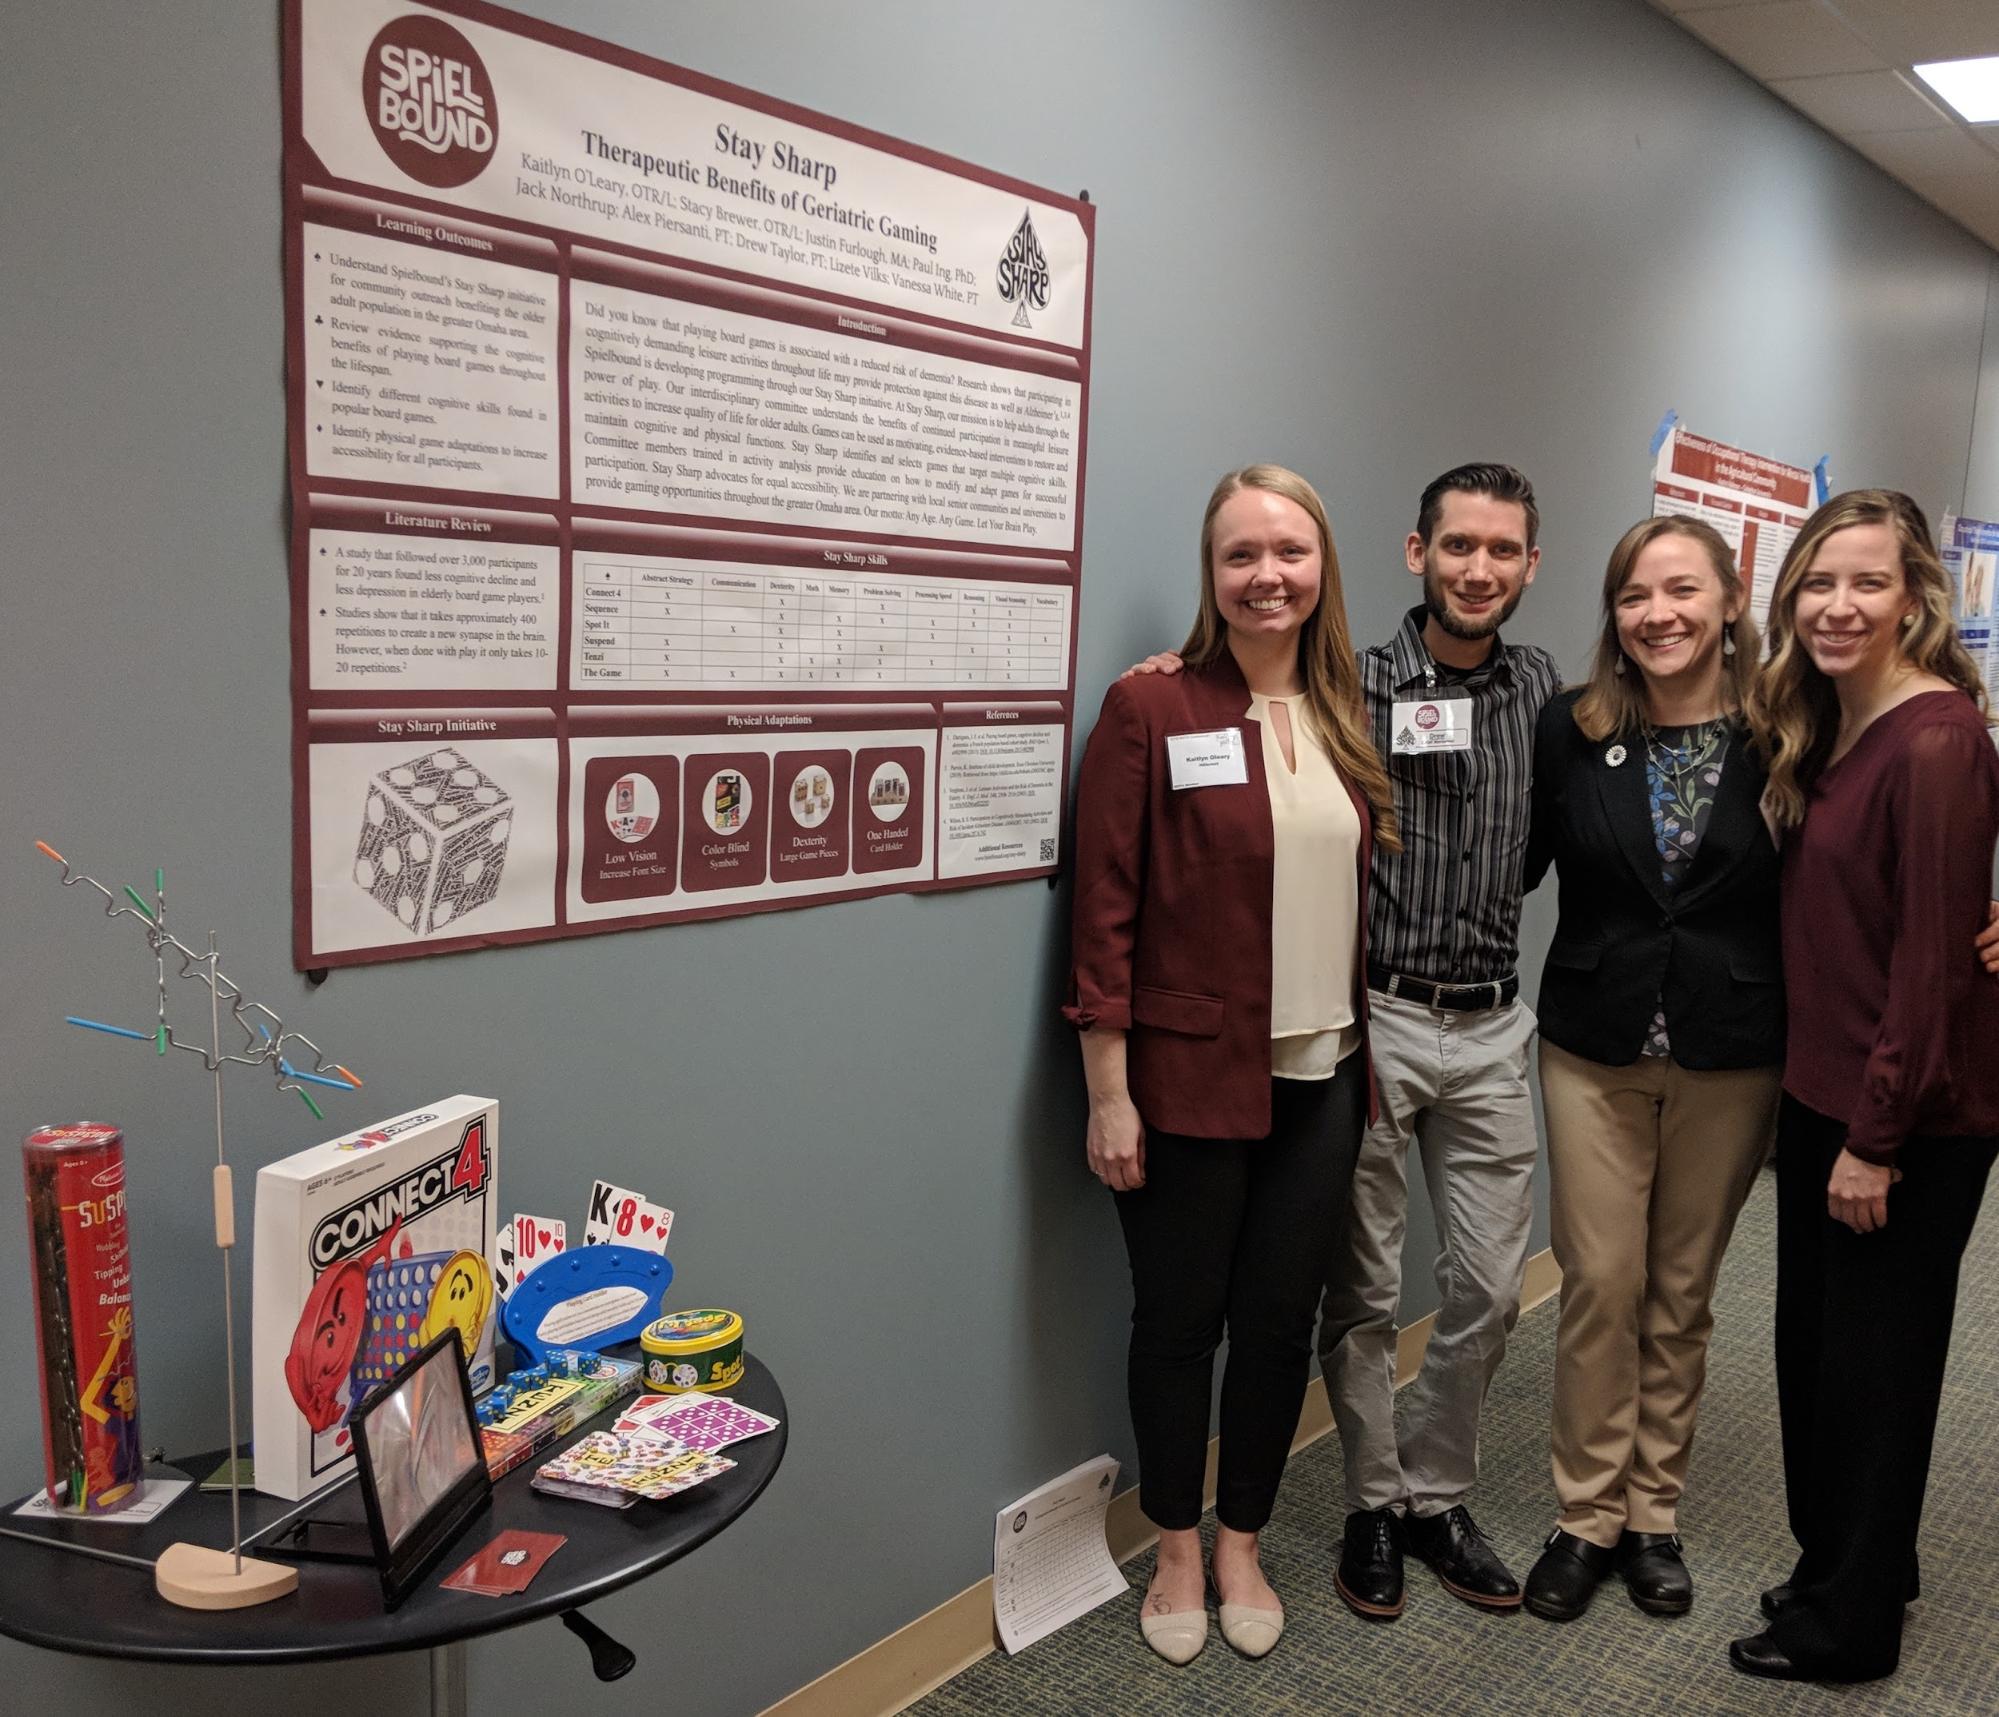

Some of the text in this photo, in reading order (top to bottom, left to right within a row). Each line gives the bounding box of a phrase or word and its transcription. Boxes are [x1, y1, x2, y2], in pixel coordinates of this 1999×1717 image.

[379, 84, 493, 154] BOUND
[681, 123, 838, 190] Stay Sharp
[581, 130, 938, 254] Therapeutic Benefits of Geriatric Gaming
[521, 153, 570, 181] Kaitlyn
[679, 195, 712, 219] Stacy
[805, 229, 836, 249] Justin
[912, 257, 933, 274] Paul
[376, 213, 492, 249] Learning Outcomes
[516, 177, 546, 198] Jack
[622, 205, 650, 224] Alex
[736, 232, 767, 253] Drew
[770, 241, 807, 263] Taylor,
[829, 256, 860, 276] Lizete
[891, 272, 931, 294] Vanessa
[966, 283, 978, 305] PT
[330, 253, 387, 274] Understand
[454, 278, 473, 293] Stay
[477, 283, 504, 299] Sharp
[998, 259, 1050, 307] SHARP
[837, 316, 886, 334] Introduction
[332, 424, 547, 459] Identify physical game adaptations to increase
[385, 510, 491, 531] Literature Review
[336, 547, 537, 570] A study that followed over 3,000 participants
[823, 548, 887, 565] Stay Sharp Skills
[335, 564, 536, 586] for 20 years found less cognitive decline and
[585, 587, 614, 596] Connect
[585, 604, 618, 616] Sequence
[585, 620, 609, 632] Spot It
[584, 636, 615, 646] Suspend
[584, 652, 603, 660] Tenzi
[584, 668, 621, 676] The Game
[378, 715, 496, 734] Stay Sharp Initiative
[727, 713, 812, 726] Physical Adaptations
[986, 709, 1019, 720] References
[792, 837, 826, 846] Dexterity
[866, 827, 908, 840] One Handed
[605, 850, 656, 863] Low Vision
[701, 841, 749, 855] Color Blind
[599, 864, 666, 878] Increase Font Size
[709, 858, 738, 870] Symbols
[315, 1126, 485, 1254] CONNECT 4
[590, 1183, 613, 1225] K
[616, 1198, 637, 1237] 8
[516, 1217, 536, 1259] 10
[710, 1356, 741, 1383] Spot
